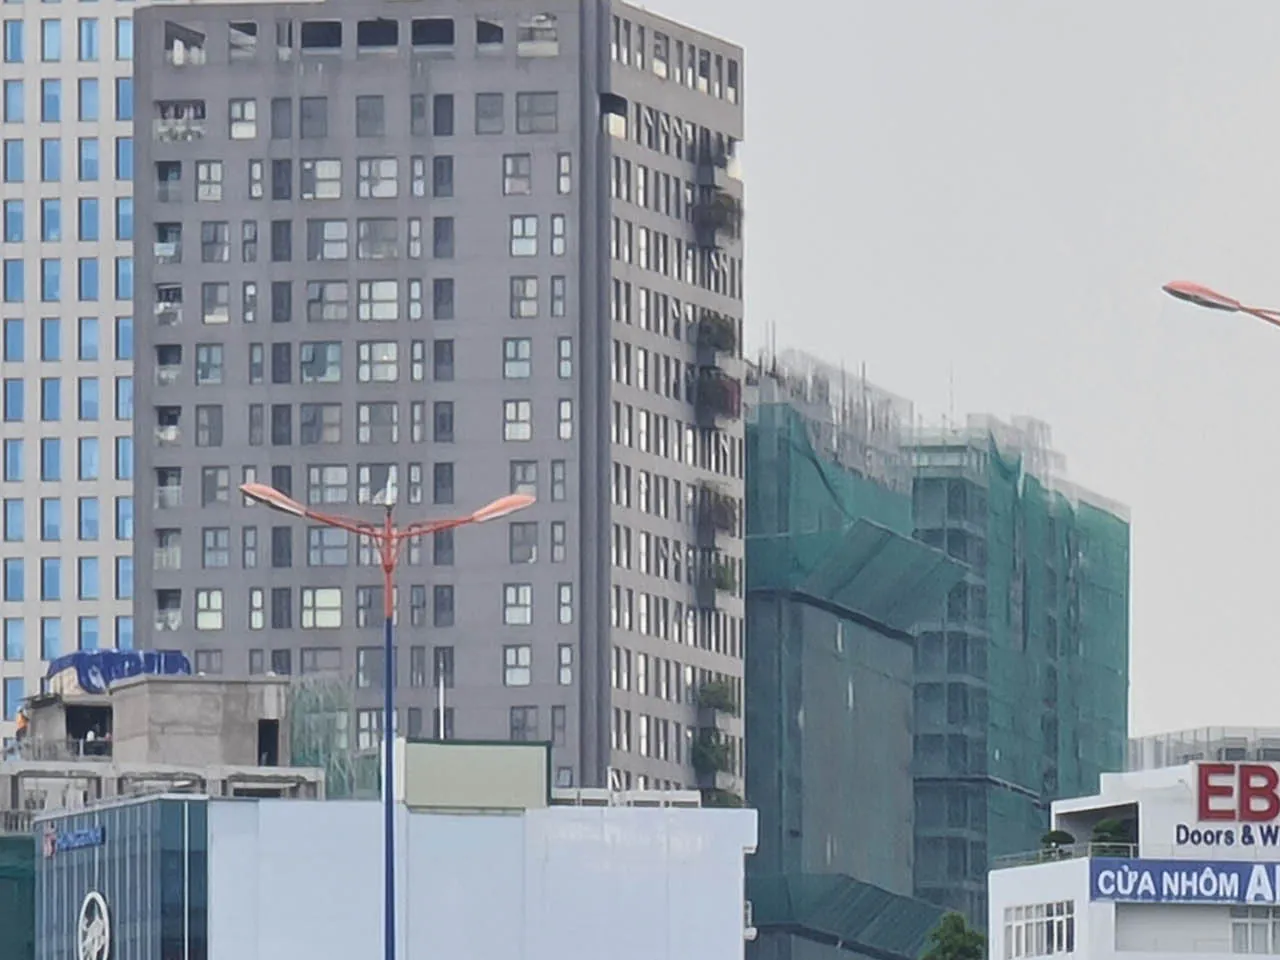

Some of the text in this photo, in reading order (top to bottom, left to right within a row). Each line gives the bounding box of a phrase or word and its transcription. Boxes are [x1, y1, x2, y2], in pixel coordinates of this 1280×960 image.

[1176, 824, 1234, 846] Doors
[1241, 826, 1255, 845] &
[1098, 865, 1156, 897] CỬA
[1163, 867, 1239, 898] NHÔM
